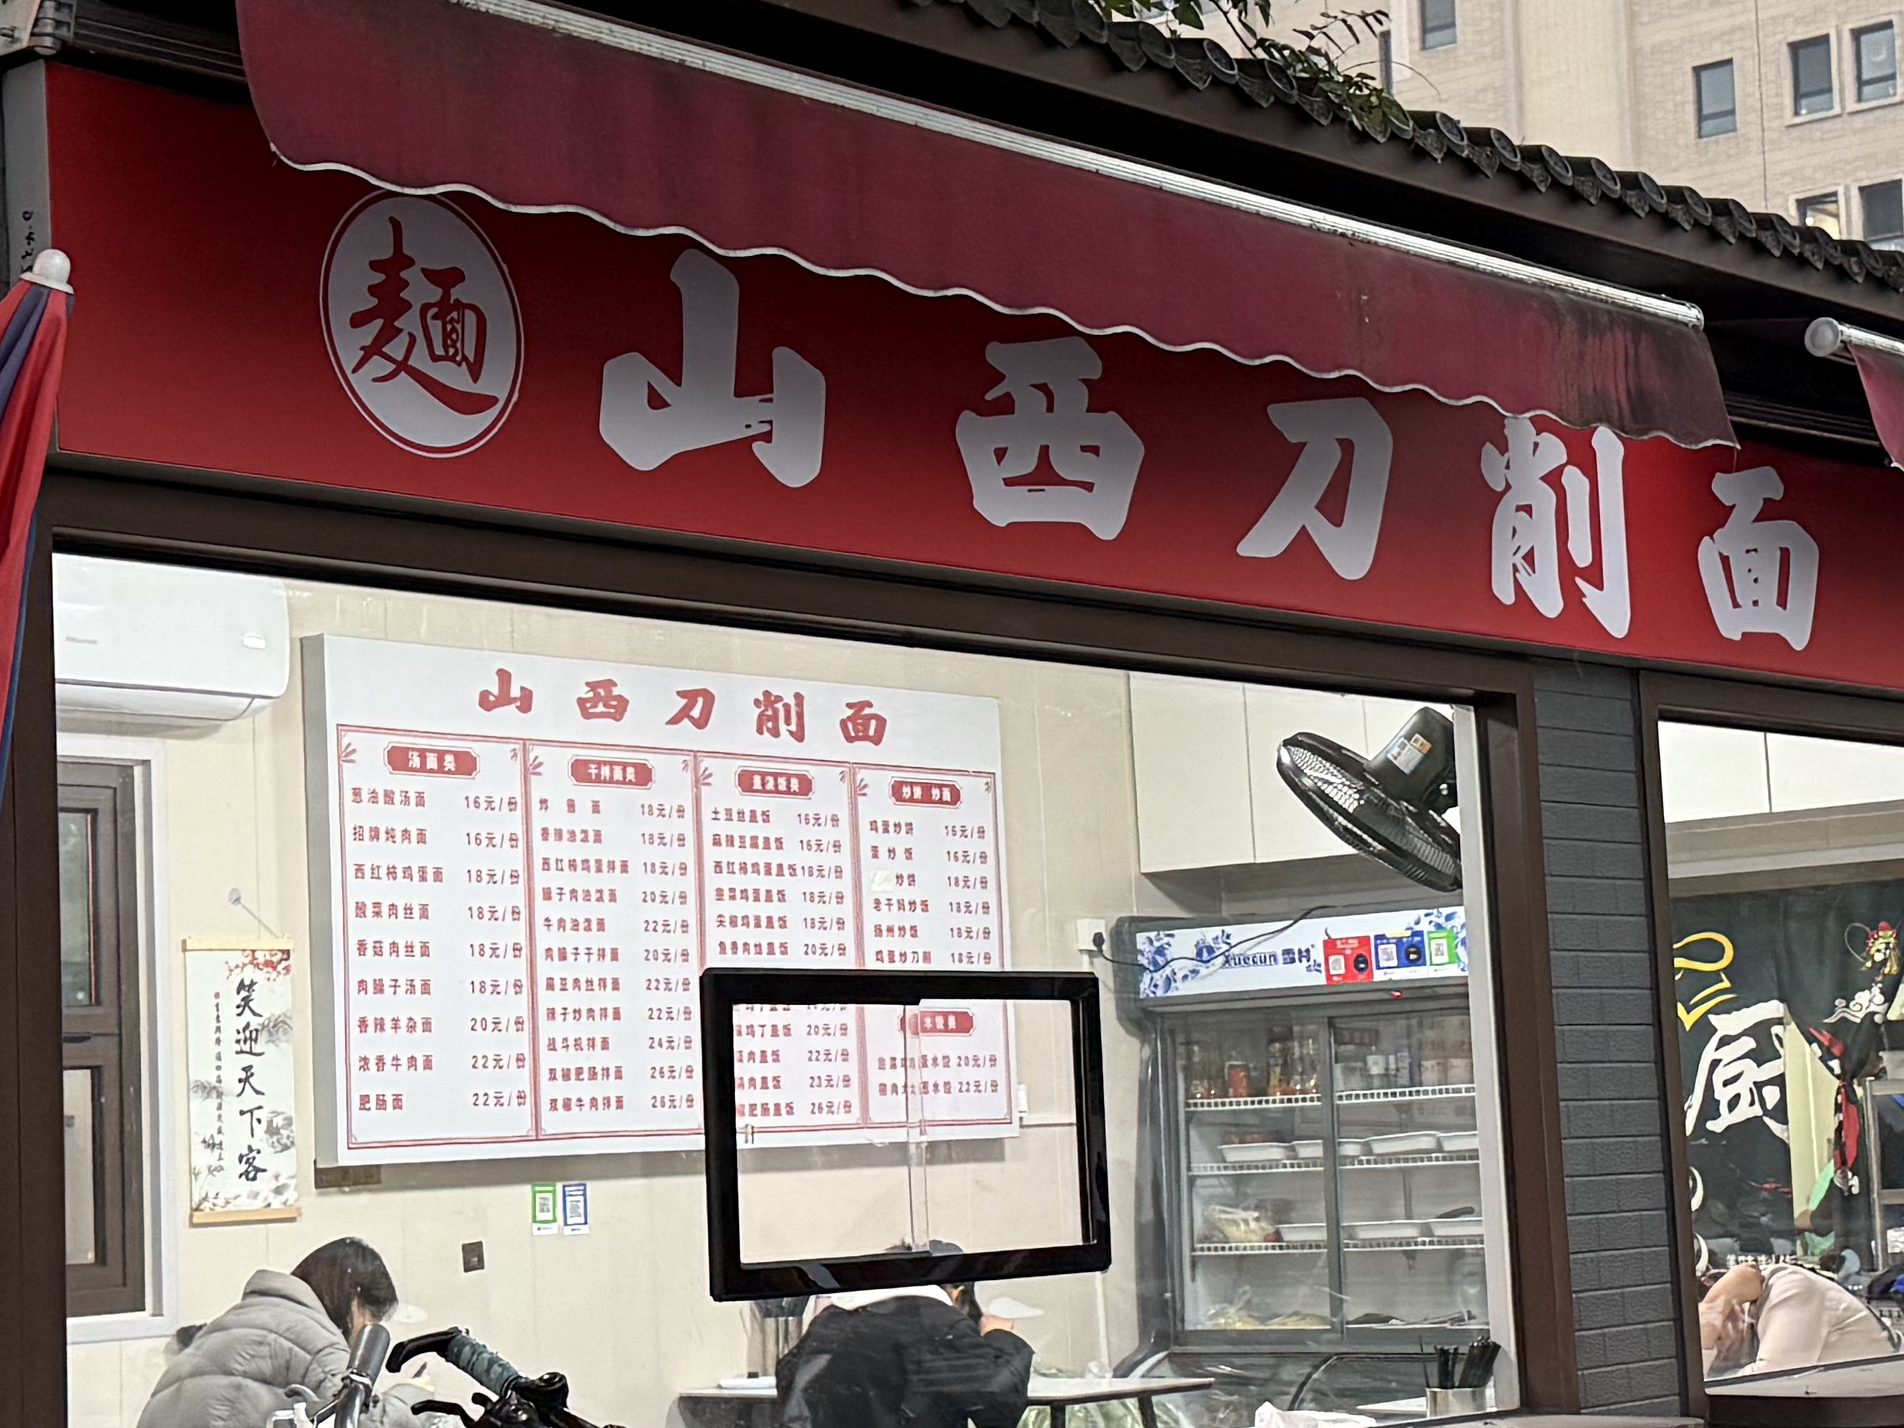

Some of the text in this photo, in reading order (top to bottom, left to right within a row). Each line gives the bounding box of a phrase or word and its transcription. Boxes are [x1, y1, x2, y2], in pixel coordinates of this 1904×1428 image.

[599, 250, 1820, 652] 山西刀削面
[478, 667, 888, 747] 山西刀削面
[408, 750, 455, 772] 汤面类
[465, 796, 517, 812] 16元/份
[711, 807, 770, 823] 土豆丝盖饭
[353, 825, 519, 848] 招牌炖肉面 16元/份
[354, 864, 520, 885] 西红柿鸡蛋面 18元/份
[542, 858, 629, 874] 西红柿鸡蛋拌面
[714, 861, 798, 877] 西红柿鸡蛋盖饭
[355, 902, 521, 922] 酸菜肉丝面 18元/份
[874, 898, 929, 912] 老干妈炒饭
[874, 924, 918, 938] 扬州炒饭
[357, 940, 522, 959] 香菇肉丝面 18元/份
[357, 978, 523, 995] 肉臊子汤面 18元/份
[358, 1016, 524, 1034] 香辣羊杂面 20元/份
[548, 1037, 610, 1052] 战斗机拌面
[359, 1053, 526, 1071] 浓香牛肉面 22元/份
[235, 977, 267, 1182] 笑迎天下客
[548, 1066, 623, 1081] 双椒肥肠拌面
[359, 1090, 526, 1111] 肥肠面 22元/份
[549, 1096, 623, 1111] 双椒牛肉拌面
